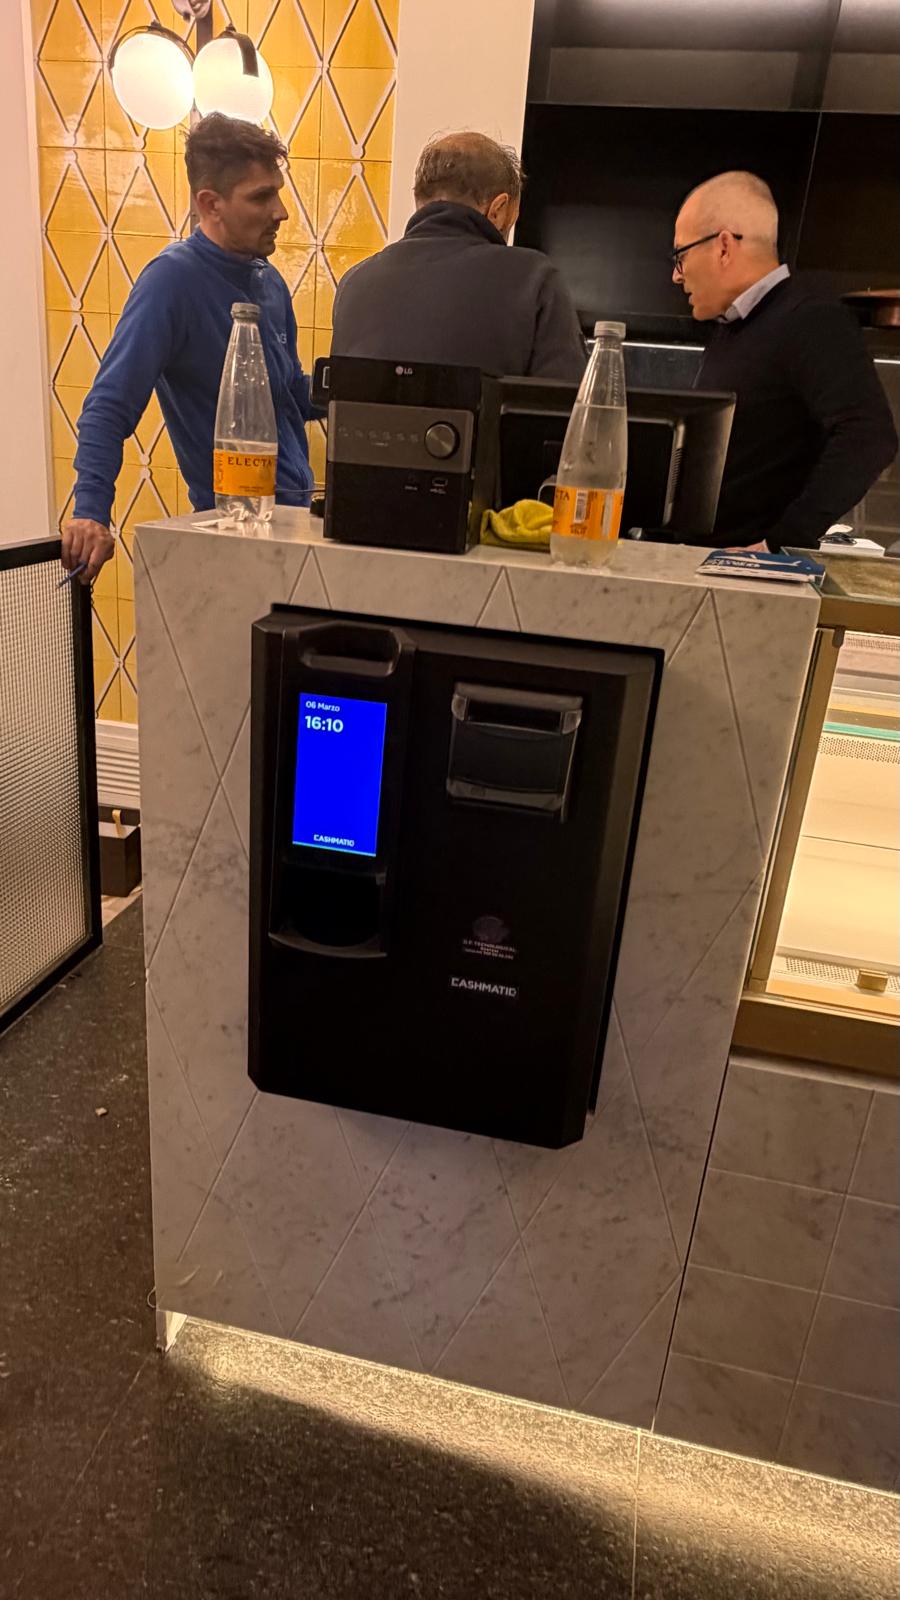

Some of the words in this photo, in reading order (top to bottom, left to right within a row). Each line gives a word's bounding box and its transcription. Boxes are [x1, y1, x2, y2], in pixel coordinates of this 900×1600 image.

[404, 367, 413, 375] LG
[227, 456, 273, 467] ELECTA
[305, 700, 316, 710] 06
[317, 702, 341, 713] Marzo
[304, 715, 344, 733] 16:10
